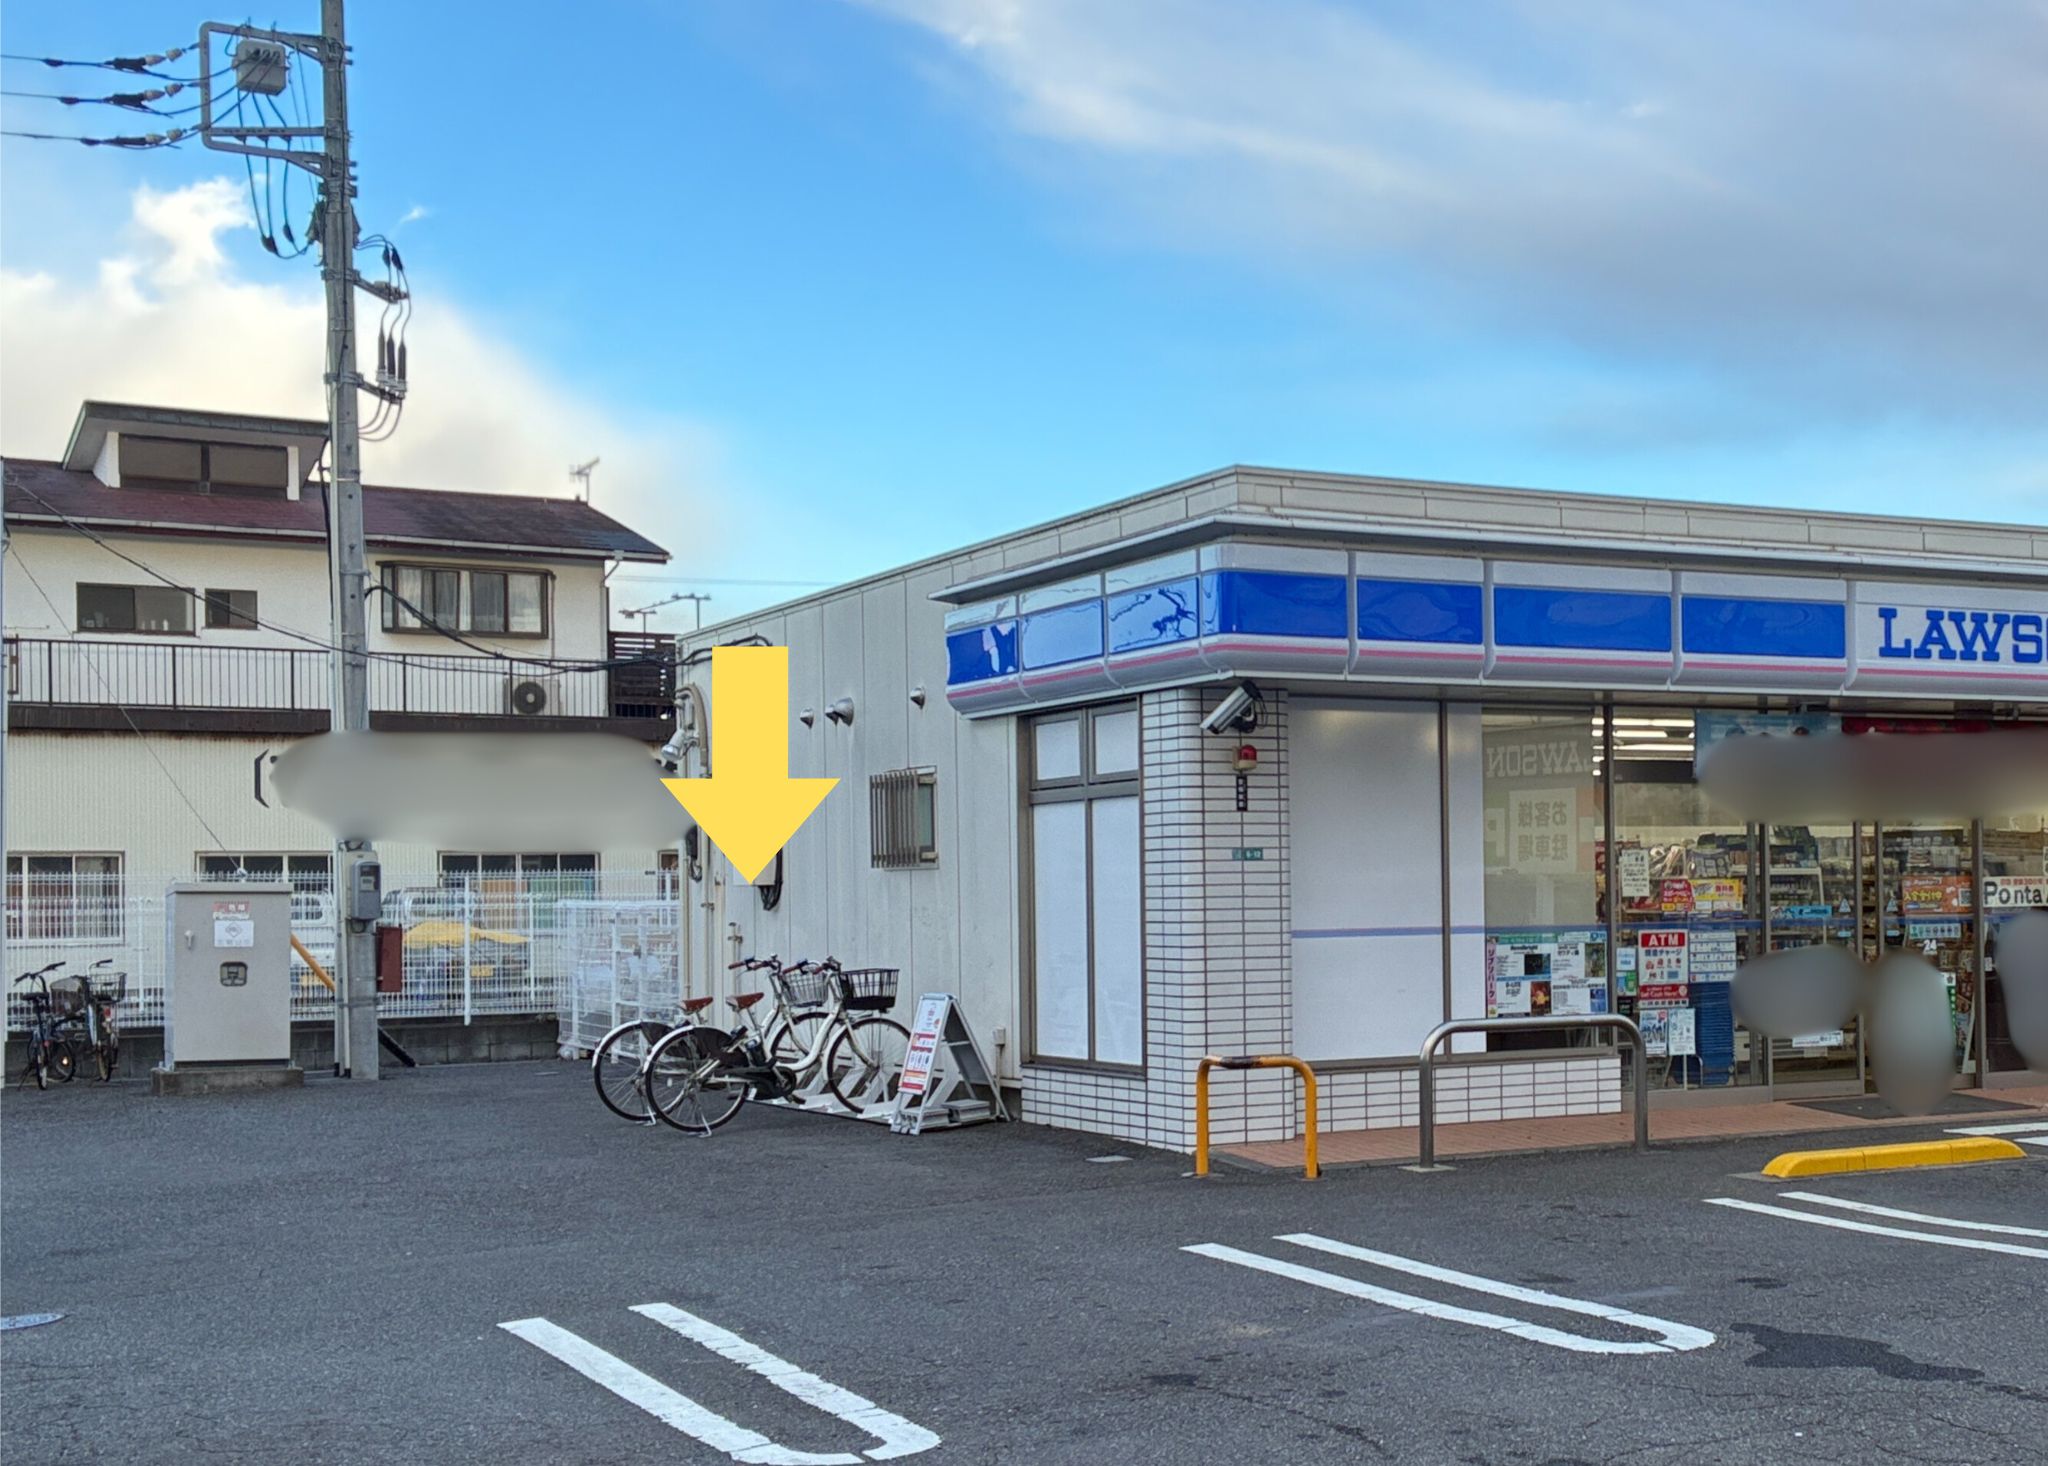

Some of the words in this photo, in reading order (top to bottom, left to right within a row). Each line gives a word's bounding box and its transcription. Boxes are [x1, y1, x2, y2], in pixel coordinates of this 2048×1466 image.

[1878, 607, 2048, 664] LAWS
[1984, 881, 2042, 905] Ponta
[1648, 933, 1679, 946] ATM
[1924, 939, 1937, 950] 24
